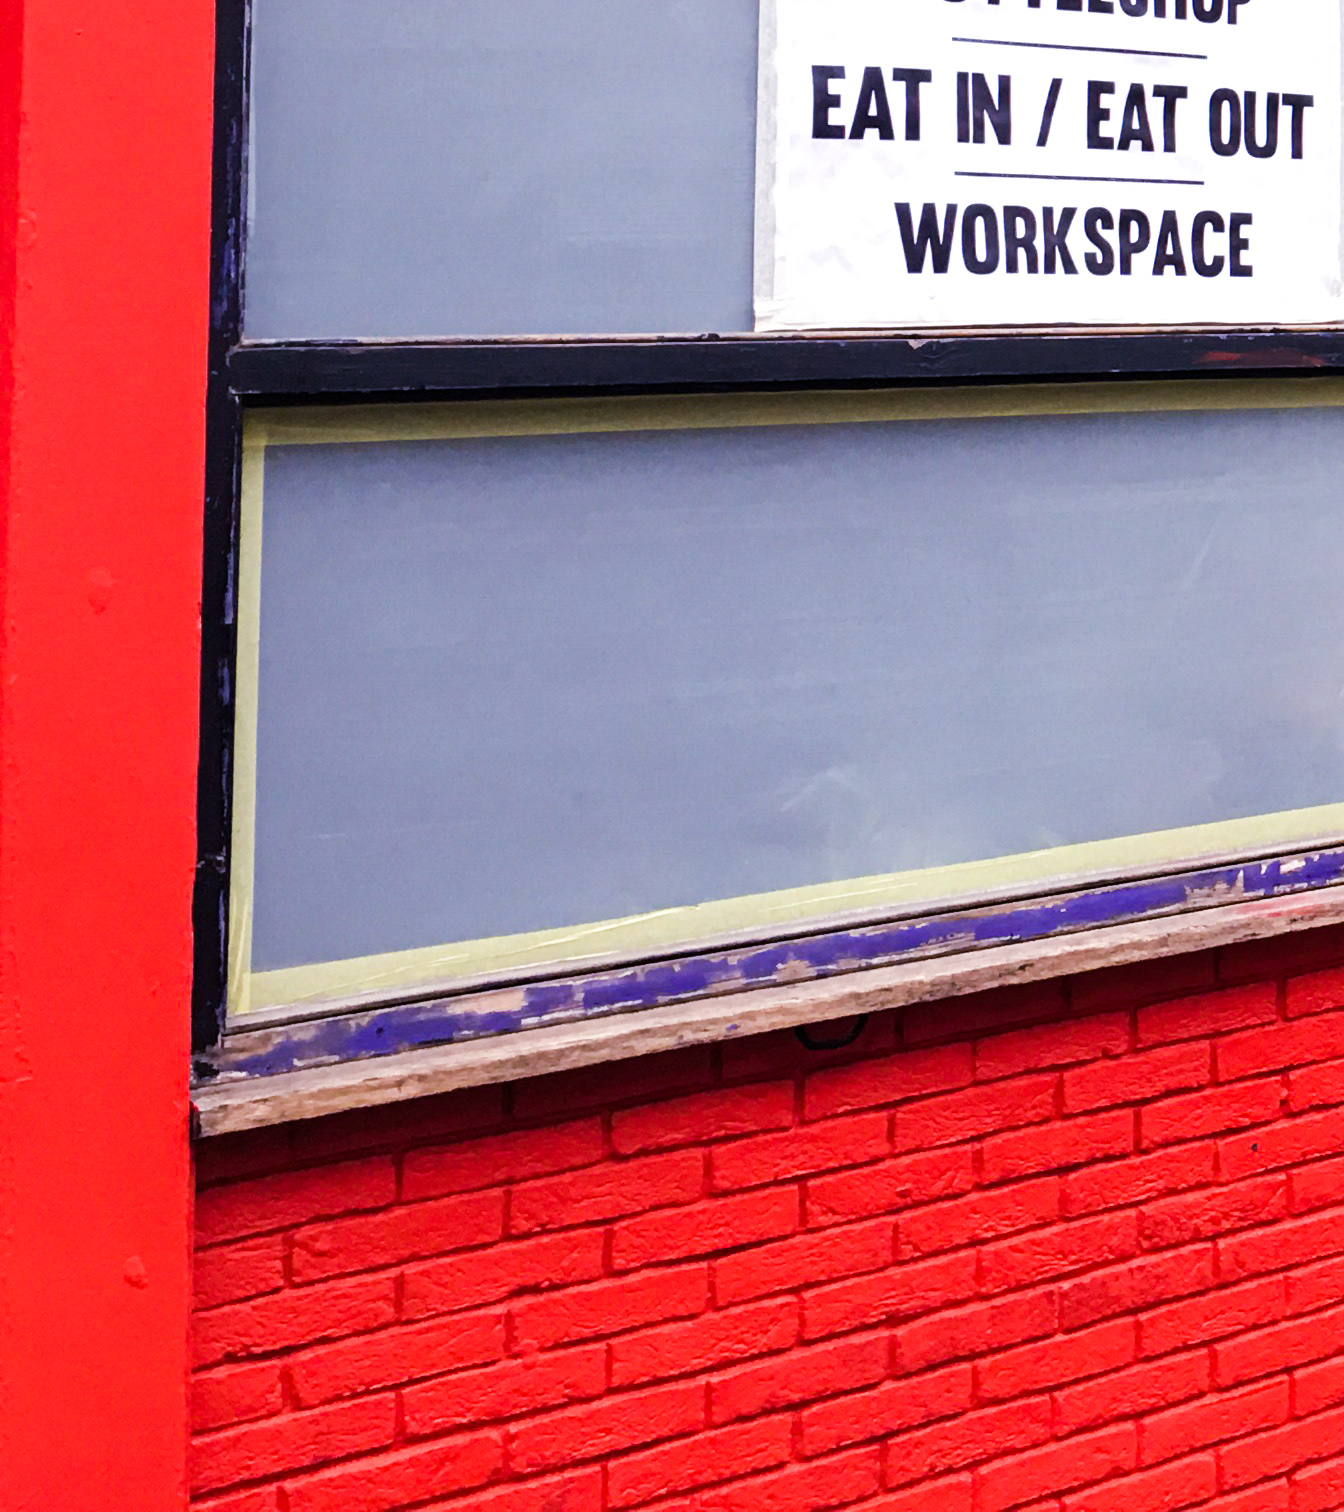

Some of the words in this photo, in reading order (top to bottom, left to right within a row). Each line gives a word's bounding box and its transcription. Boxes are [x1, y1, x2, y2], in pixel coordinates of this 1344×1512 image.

[812, 66, 931, 140] EAT
[957, 72, 1011, 145] IN
[1037, 78, 1062, 146] /
[1087, 81, 1187, 152] EAT
[1209, 88, 1313, 159] OUT
[895, 203, 1252, 277] WORKSPACE
